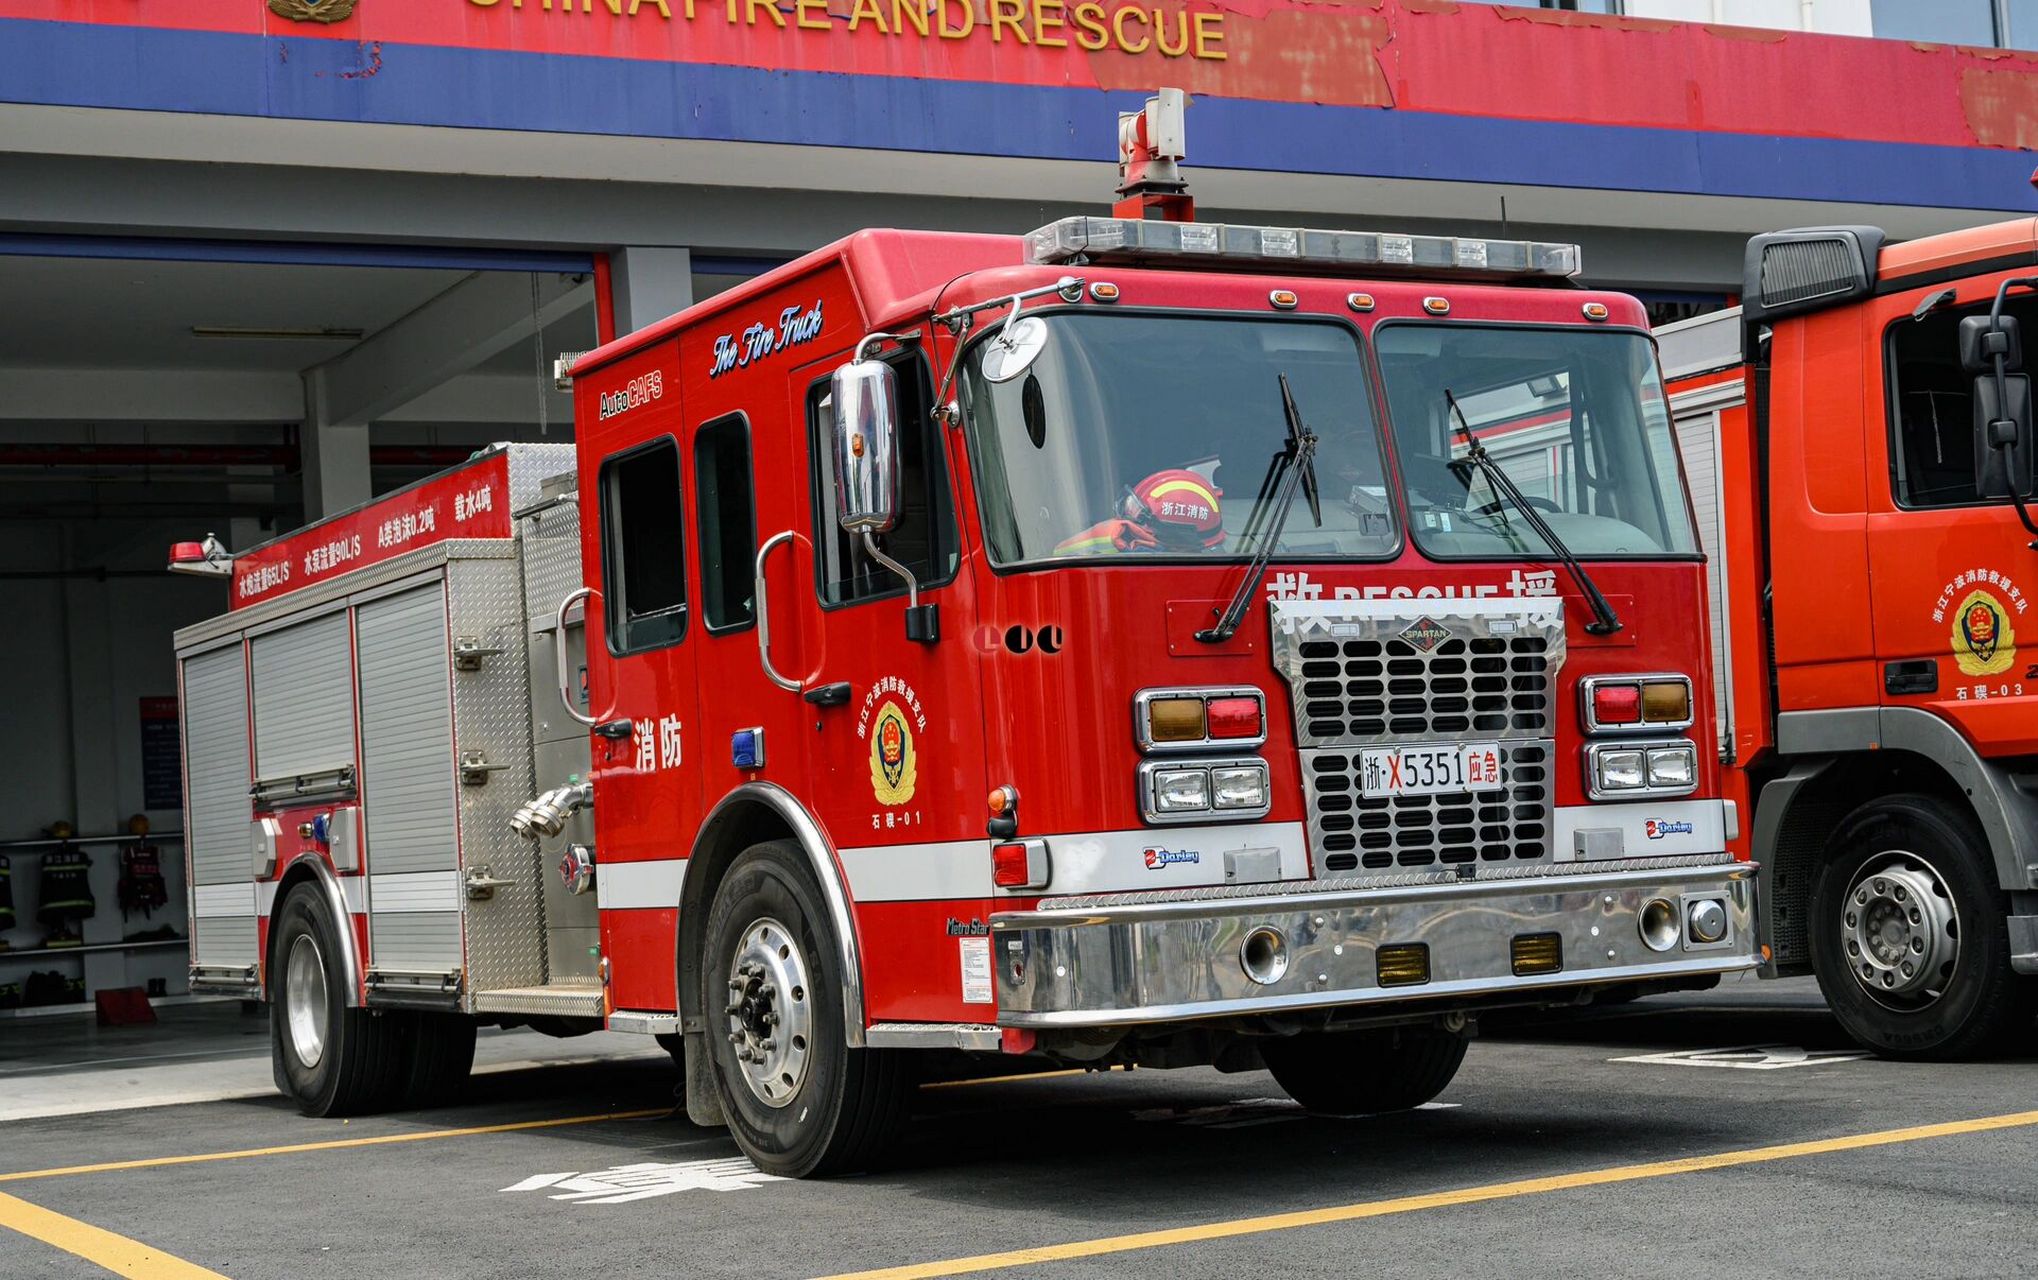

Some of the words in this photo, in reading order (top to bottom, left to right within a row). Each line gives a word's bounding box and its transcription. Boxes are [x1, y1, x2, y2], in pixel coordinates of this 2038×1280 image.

[848, 0, 974, 40] AND
[991, 0, 1228, 61] RESCUE
[709, 333, 739, 379] The
[738, 321, 775, 367] Fire
[774, 298, 825, 351] Truck
[599, 369, 663, 421] AutoCAFS
[454, 483, 493, 522] 载水4吨
[1161, 501, 1209, 520] 浙江消防
[1334, 585, 1506, 622] RESCUE
[1932, 568, 2029, 625] 浙江宁波消防救援支队
[1406, 629, 1447, 639] SPARTAN
[857, 675, 927, 740] 浙江宁波消防救援支队
[634, 712, 682, 773] 消防
[1658, 821, 1692, 834] Darley
[1159, 850, 1199, 864] Darley
[946, 916, 970, 936] Metro
[970, 917, 990, 936] Star
